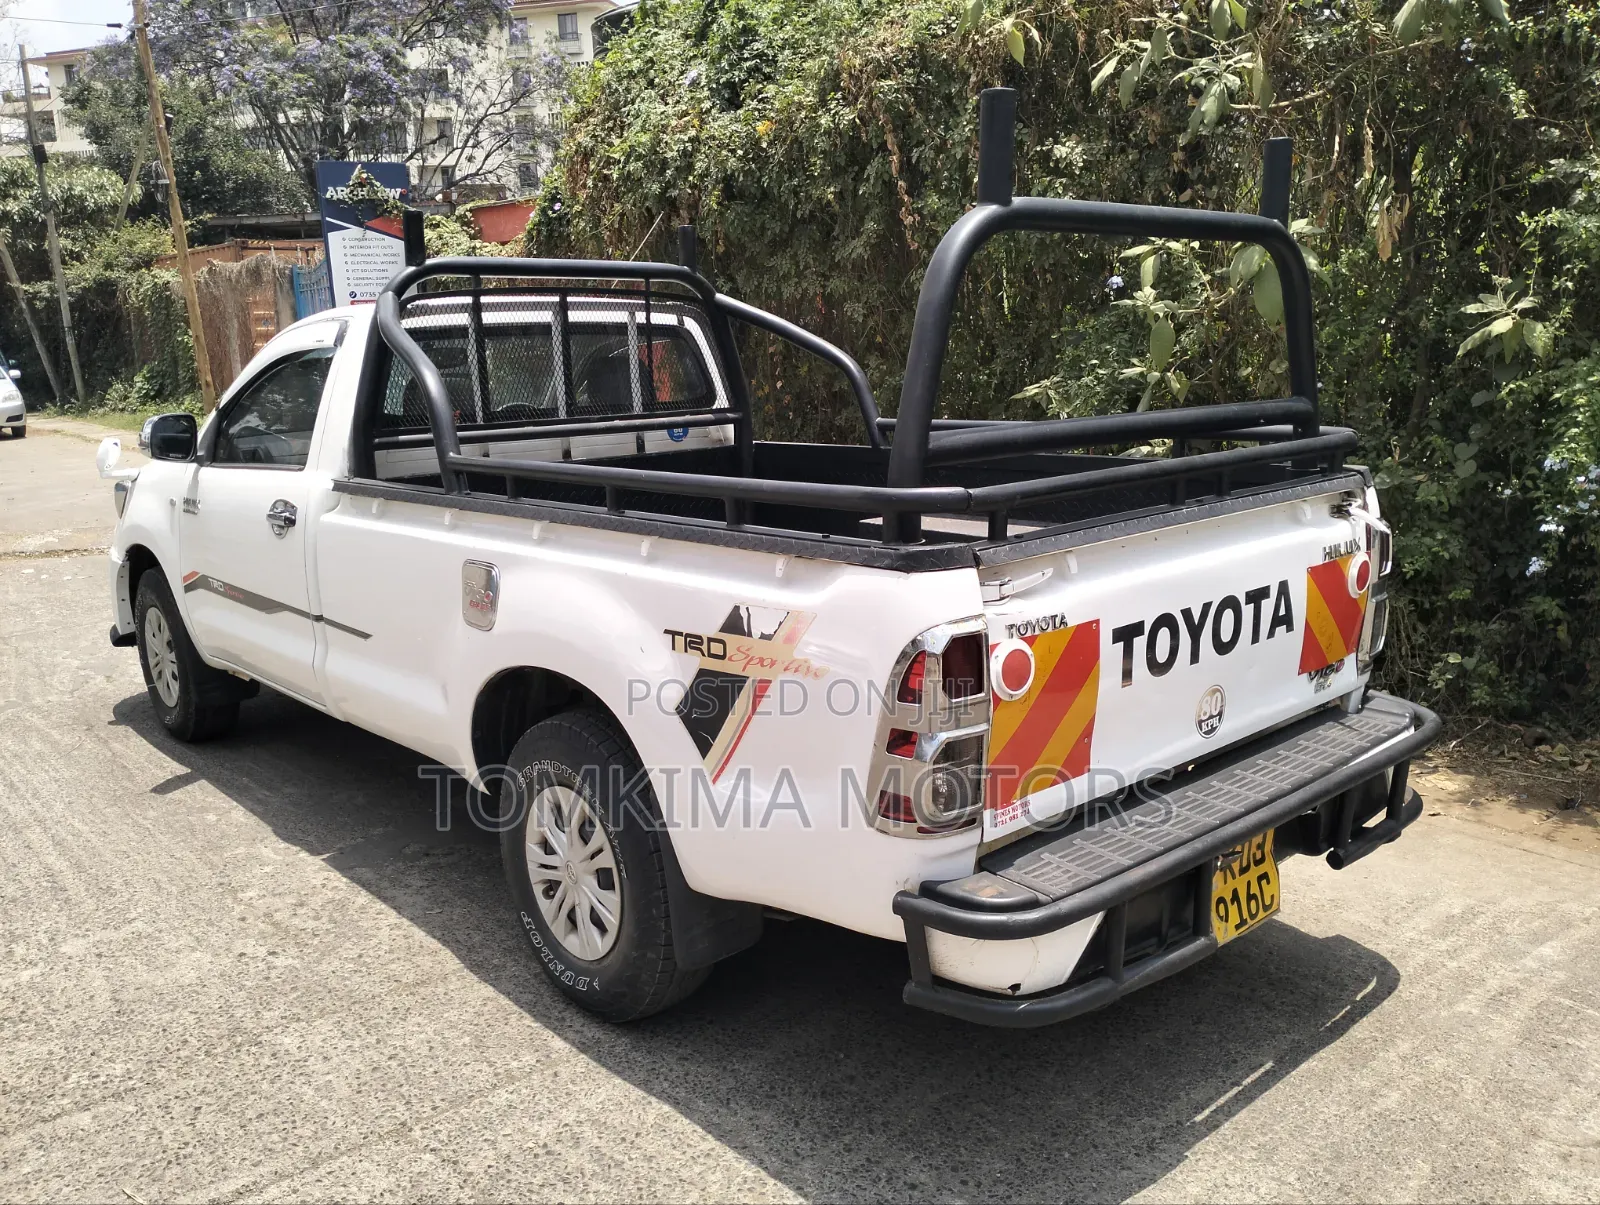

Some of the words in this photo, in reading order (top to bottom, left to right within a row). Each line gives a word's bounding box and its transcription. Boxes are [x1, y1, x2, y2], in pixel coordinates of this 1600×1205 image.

[1322, 537, 1361, 561] HILUX
[208, 578, 224, 592] TRD
[1005, 612, 1068, 639] TOYOTA
[1112, 579, 1294, 688] TOYOTA
[663, 628, 727, 660] TRD
[1199, 692, 1224, 720] 80
[1201, 716, 1220, 736] KPH
[1215, 871, 1275, 938] 916C
[520, 912, 590, 990] DUNLOP
